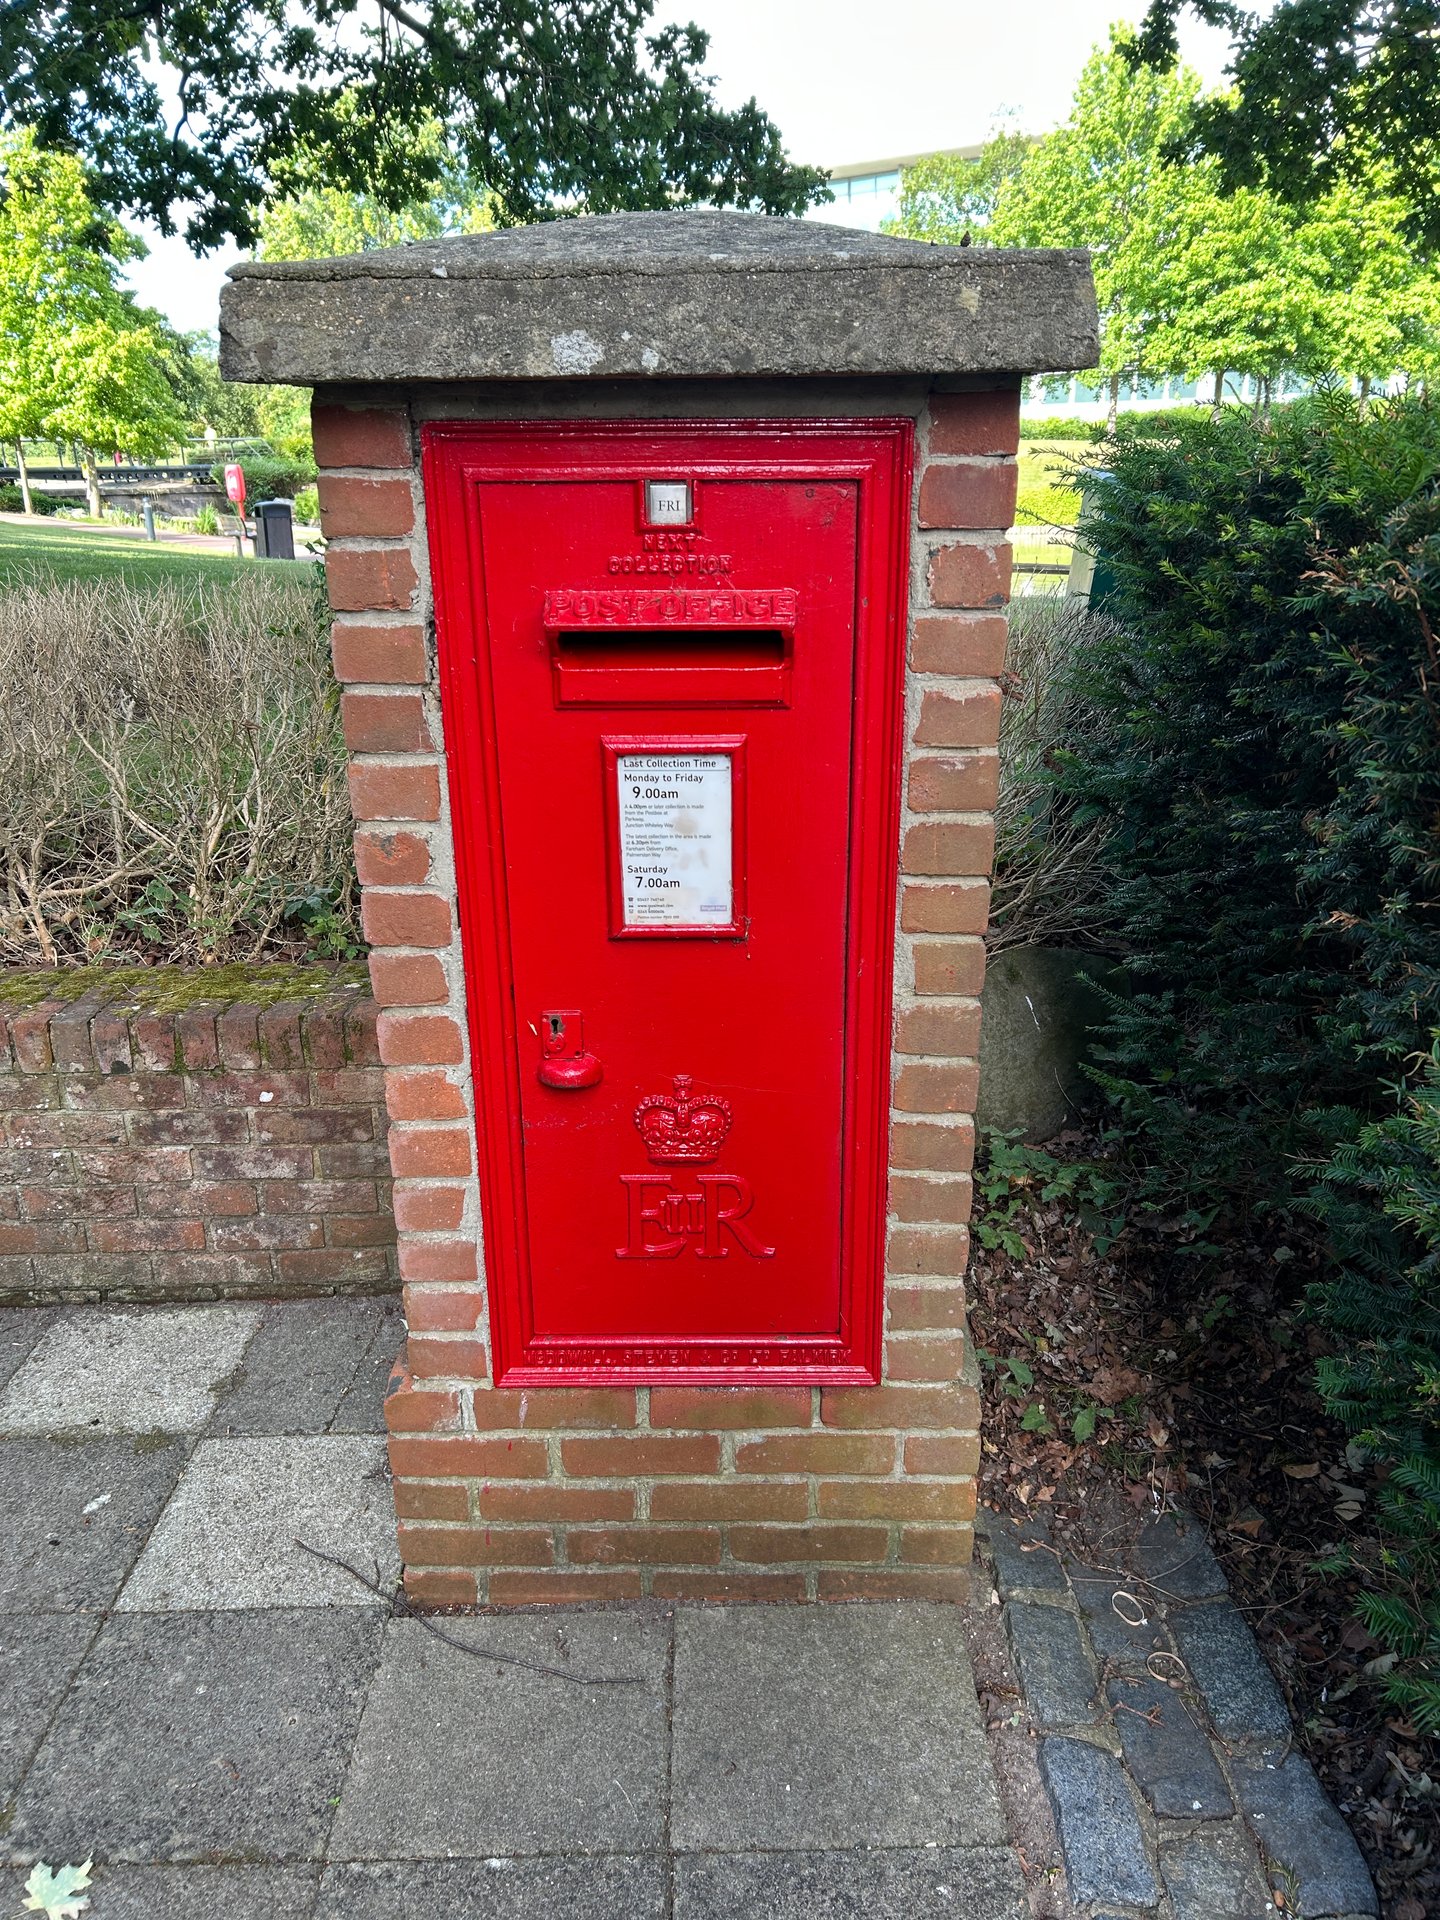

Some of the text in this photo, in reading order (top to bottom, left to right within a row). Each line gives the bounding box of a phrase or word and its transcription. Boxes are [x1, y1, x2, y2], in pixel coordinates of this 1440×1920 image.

[658, 500, 680, 511] FRI
[643, 534, 696, 551] NEXT
[608, 555, 732, 575] COLLECTION
[550, 594, 794, 620] POST OFFICE
[624, 758, 716, 768] Last Collection Time
[624, 774, 704, 783] Monday to Friday
[632, 786, 678, 799] 9.00am
[627, 865, 668, 874] Saturday
[635, 877, 680, 888] 7.00am
[624, 1350, 690, 1365] STEVEN
[779, 1350, 851, 1364] FALKIRK
